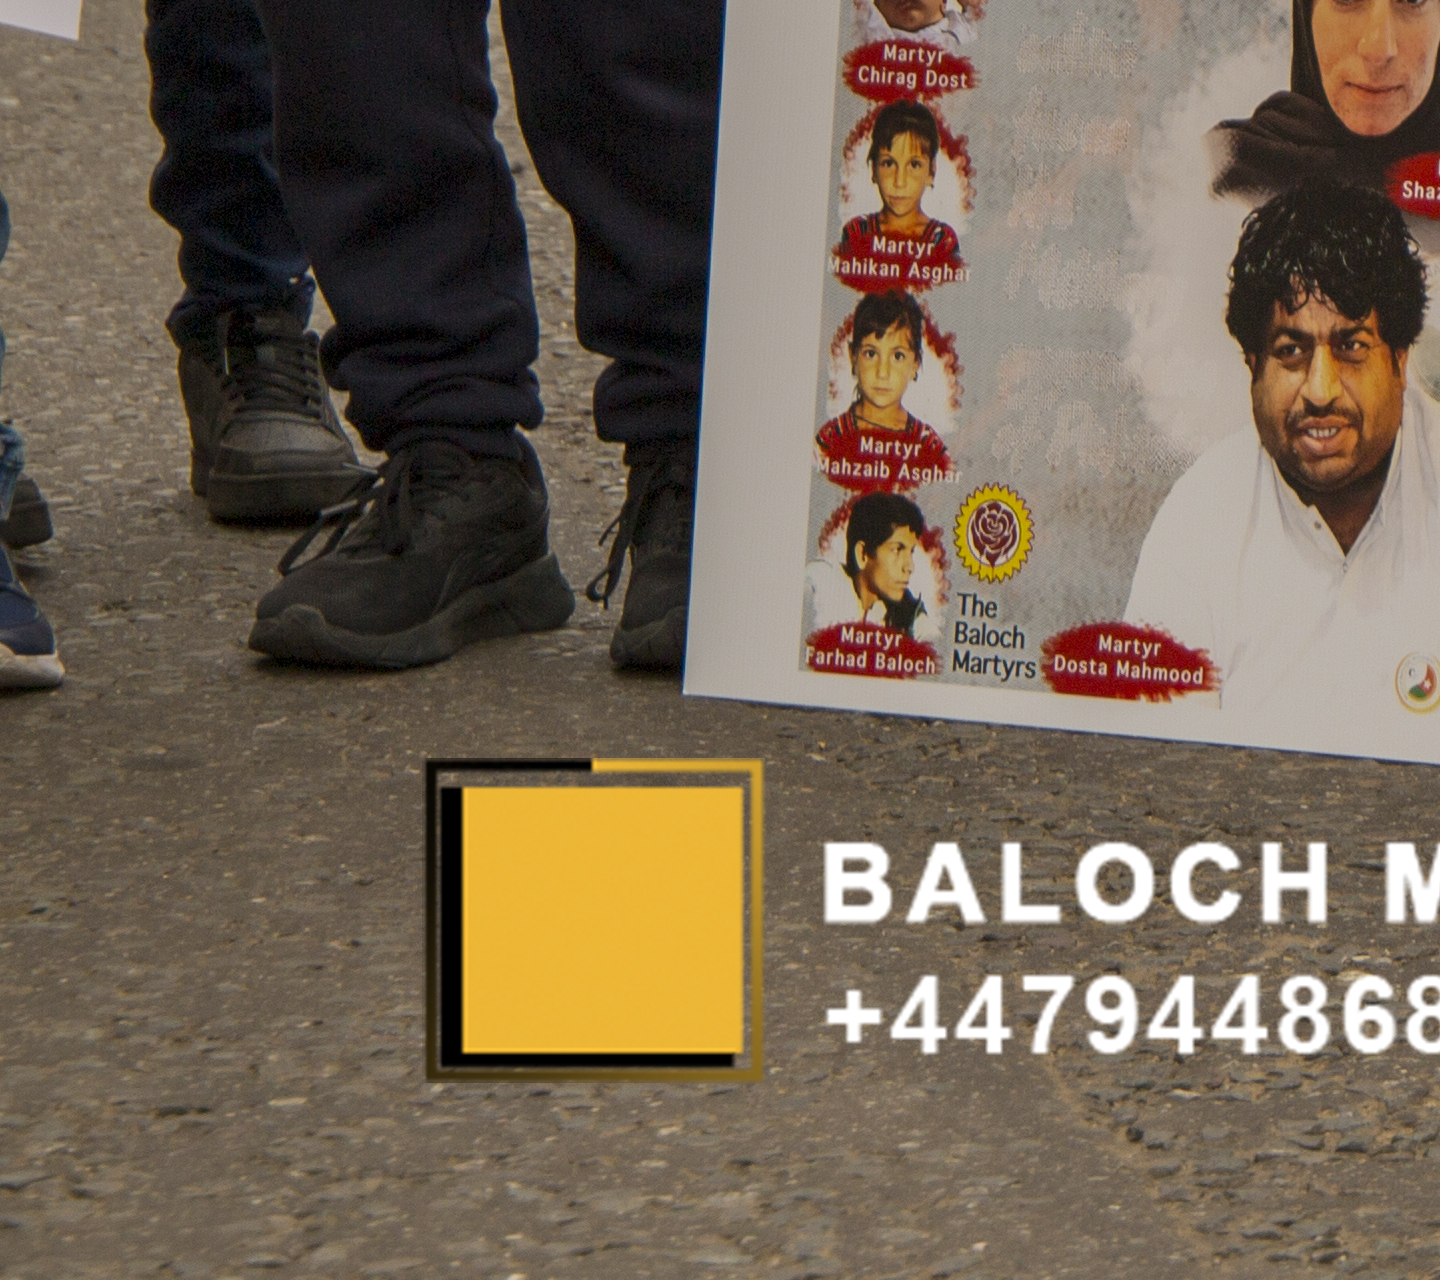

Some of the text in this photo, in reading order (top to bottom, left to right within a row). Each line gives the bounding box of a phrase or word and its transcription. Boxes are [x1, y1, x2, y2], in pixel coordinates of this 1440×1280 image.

[883, 44, 946, 67] Martyr
[858, 66, 968, 90] Chirag Dost
[872, 236, 934, 258] Martyr
[828, 256, 972, 284] Mahikan Asghar
[860, 436, 922, 459] Martyr
[816, 458, 963, 486] Mahzaib Asghar
[958, 592, 998, 618] The
[840, 626, 904, 648] Martyr
[954, 621, 1025, 650] Baloch
[1098, 634, 1162, 657] Martyr
[805, 648, 936, 675] Farhad Baloch
[952, 651, 1036, 681] Martyrs
[1053, 654, 1204, 685] Dosta Mahmood
